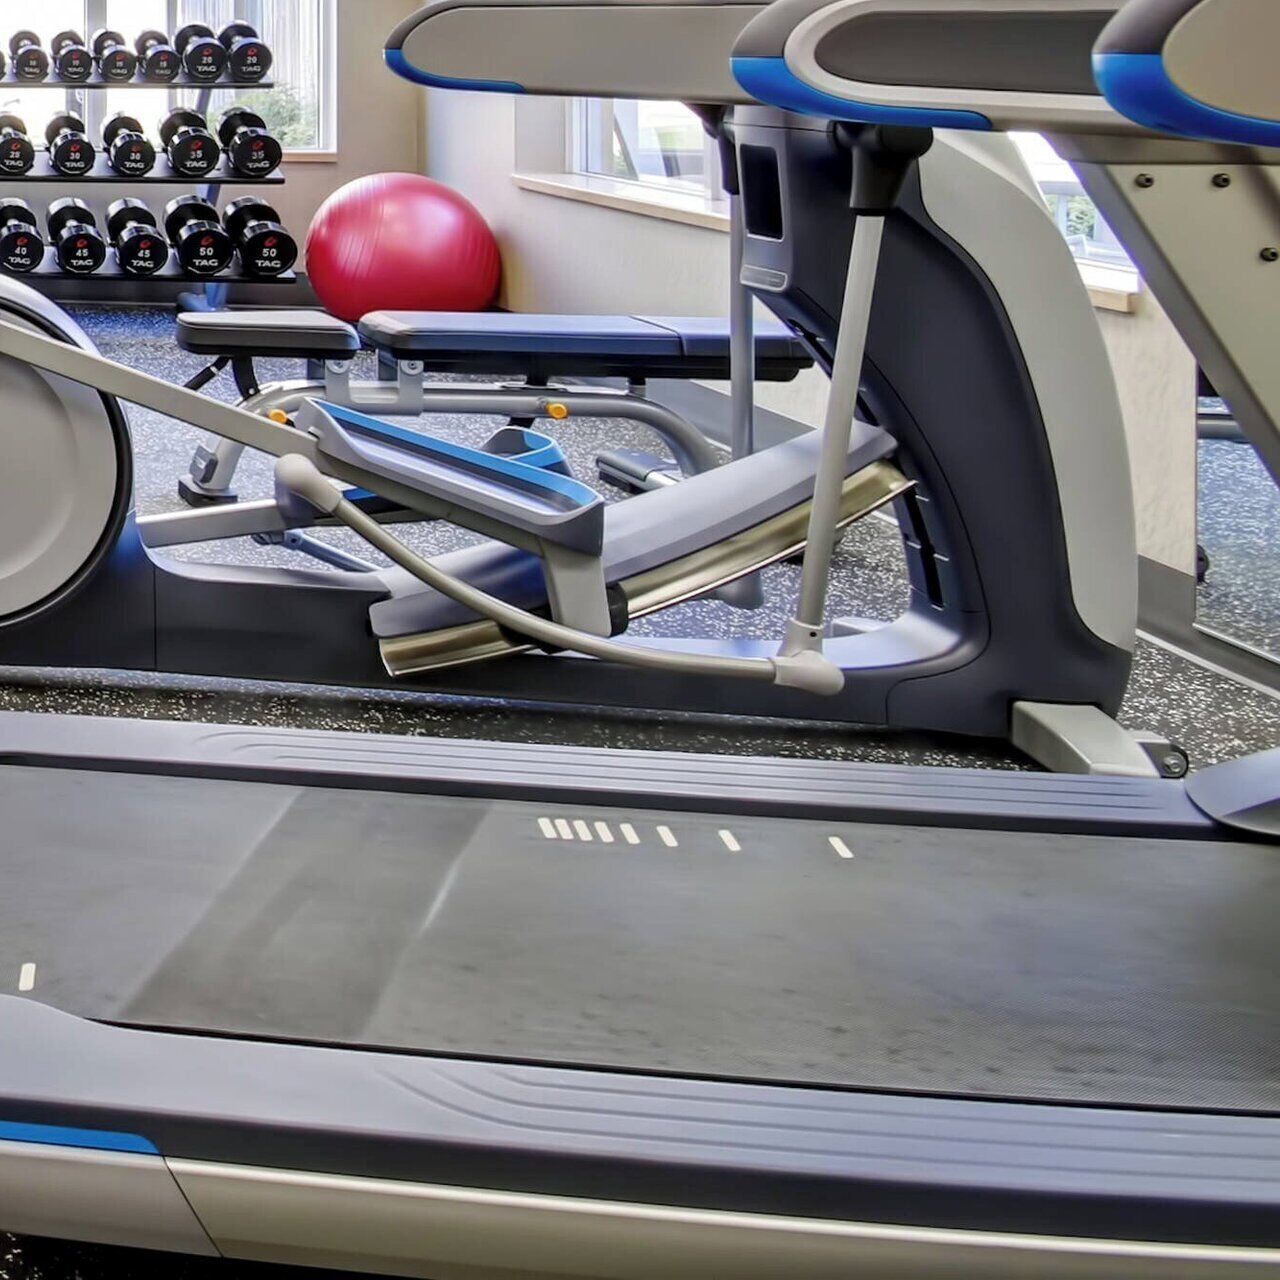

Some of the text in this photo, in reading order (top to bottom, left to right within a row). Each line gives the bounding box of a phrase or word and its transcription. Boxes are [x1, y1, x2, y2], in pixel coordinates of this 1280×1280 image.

[202, 56, 213, 64] 20
[247, 56, 257, 64] 20
[10, 151, 20, 159] 25
[70, 152, 81, 160] 30
[191, 150, 202, 158] 35
[252, 151, 264, 159] 35
[246, 161, 270, 169] TAG
[15, 247, 27, 255] 40
[76, 249, 88, 257] 45
[138, 249, 151, 258] 45
[199, 247, 214, 256] 50
[262, 248, 277, 257] 50
[8, 256, 31, 265] TAG
[131, 260, 154, 268] TAG
[193, 259, 218, 267] TAG
[255, 260, 282, 268] TAG
